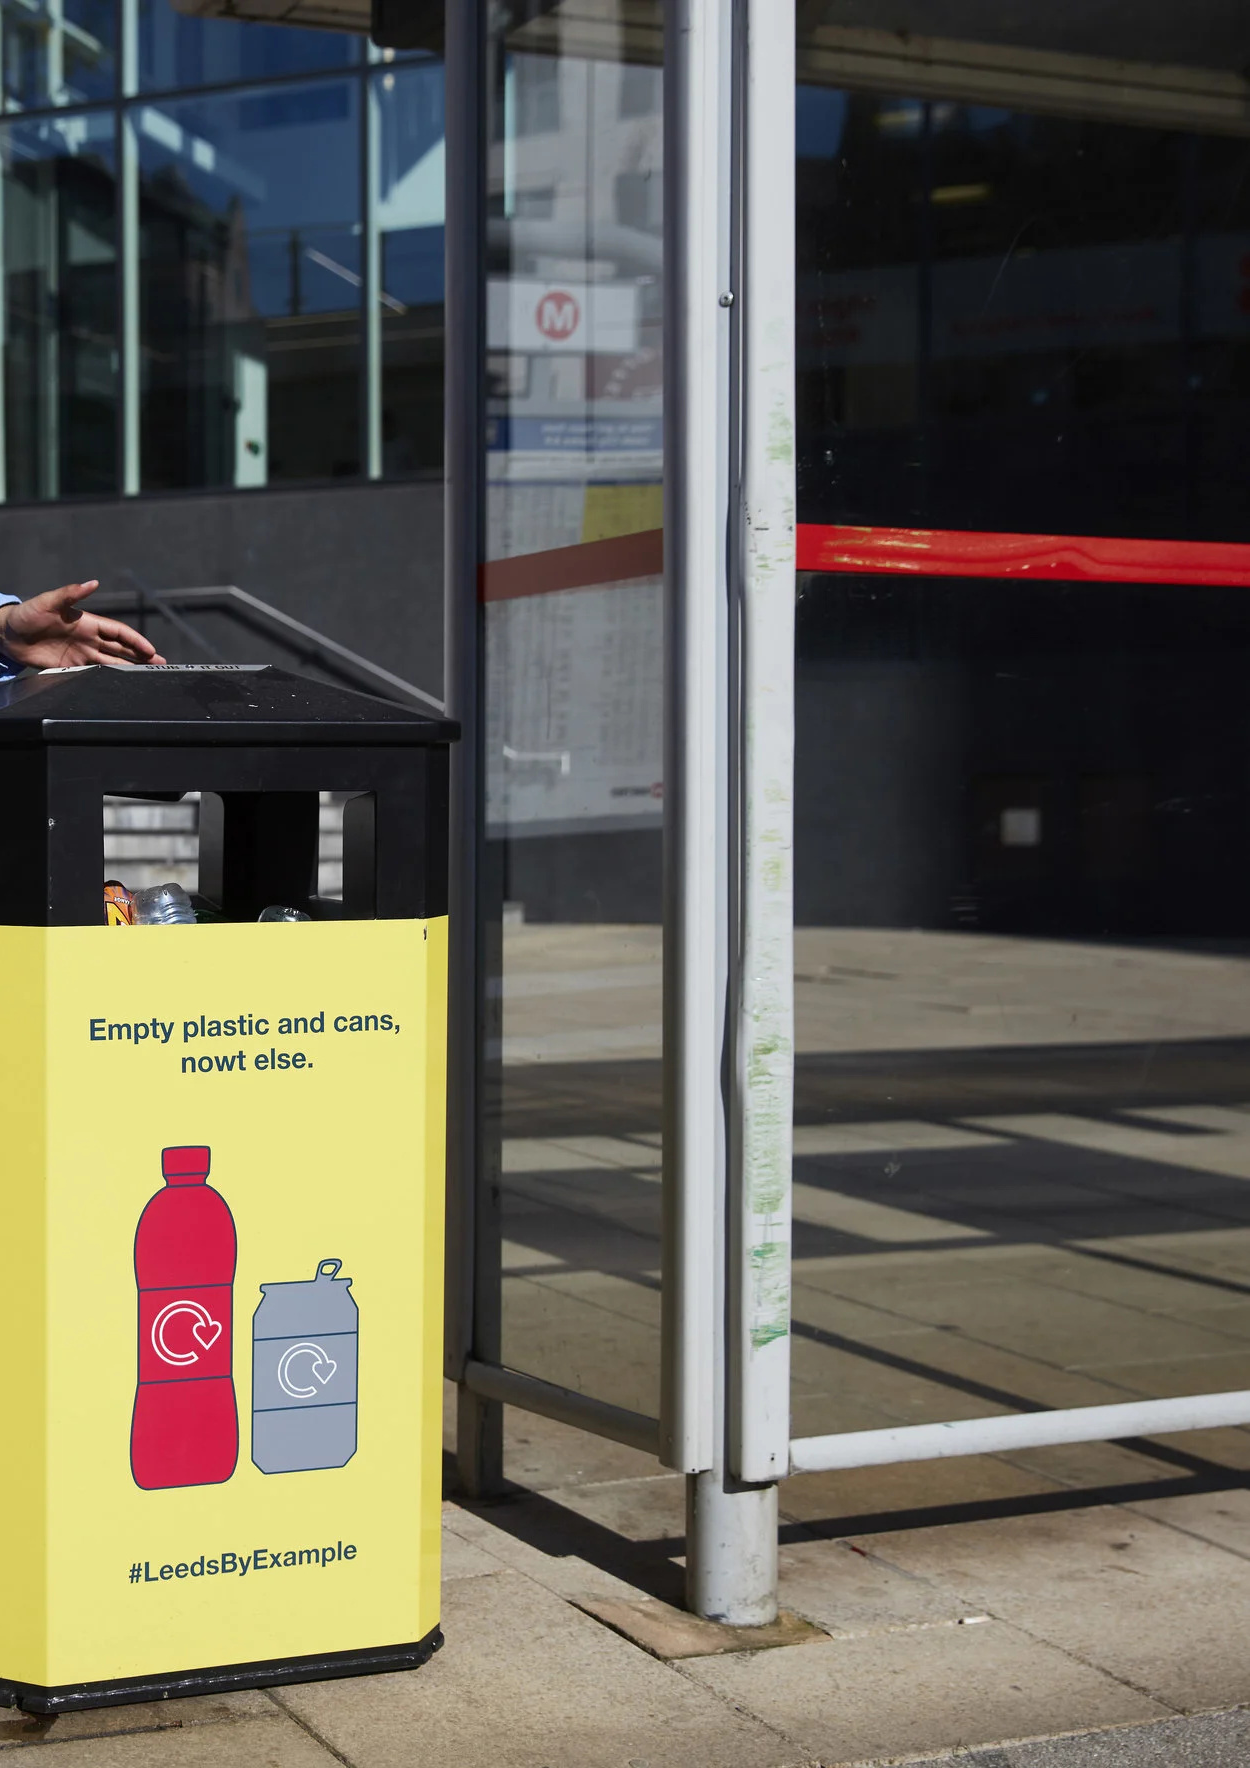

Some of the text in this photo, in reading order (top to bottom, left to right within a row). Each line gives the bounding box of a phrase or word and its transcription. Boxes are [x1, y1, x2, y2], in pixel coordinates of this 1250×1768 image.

[89, 1011, 401, 1044] Empty plastic and cans,
[181, 1047, 314, 1074] nowt else.
[128, 1540, 358, 1584] #LeedsByExample
